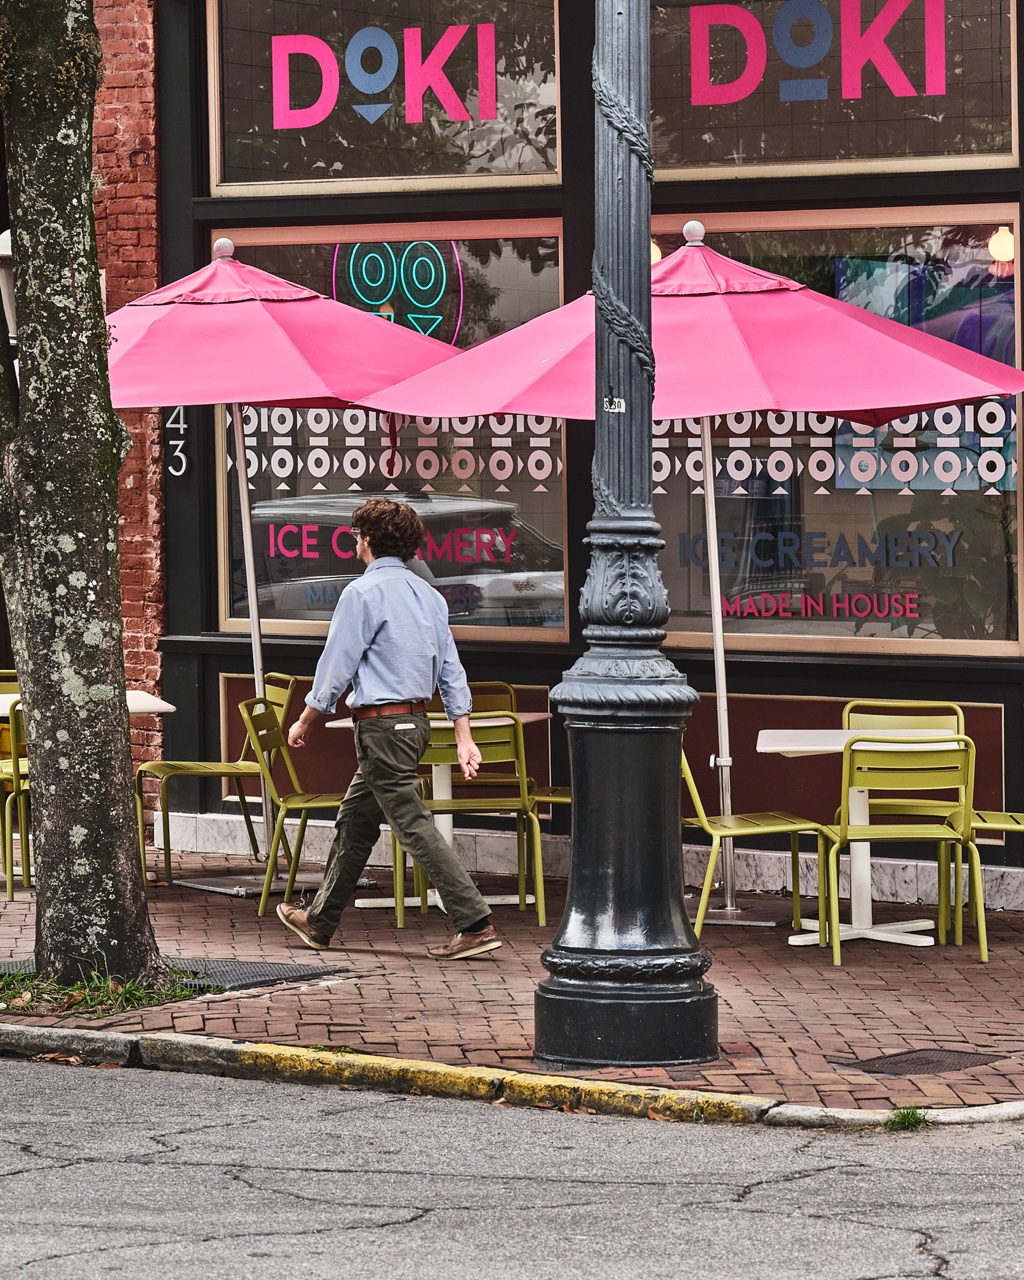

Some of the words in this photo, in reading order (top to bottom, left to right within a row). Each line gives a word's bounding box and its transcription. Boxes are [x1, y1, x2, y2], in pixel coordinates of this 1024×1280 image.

[271, 23, 497, 130] DOKI
[604, 400, 622, 410] S30
[268, 523, 320, 559] ICE
[331, 525, 518, 564] CMERY
[678, 531, 736, 568] ICE
[750, 531, 962, 568] CREAMERY
[721, 593, 792, 618] MADE
[801, 593, 824, 617] IN
[832, 593, 920, 618] HOUSE
